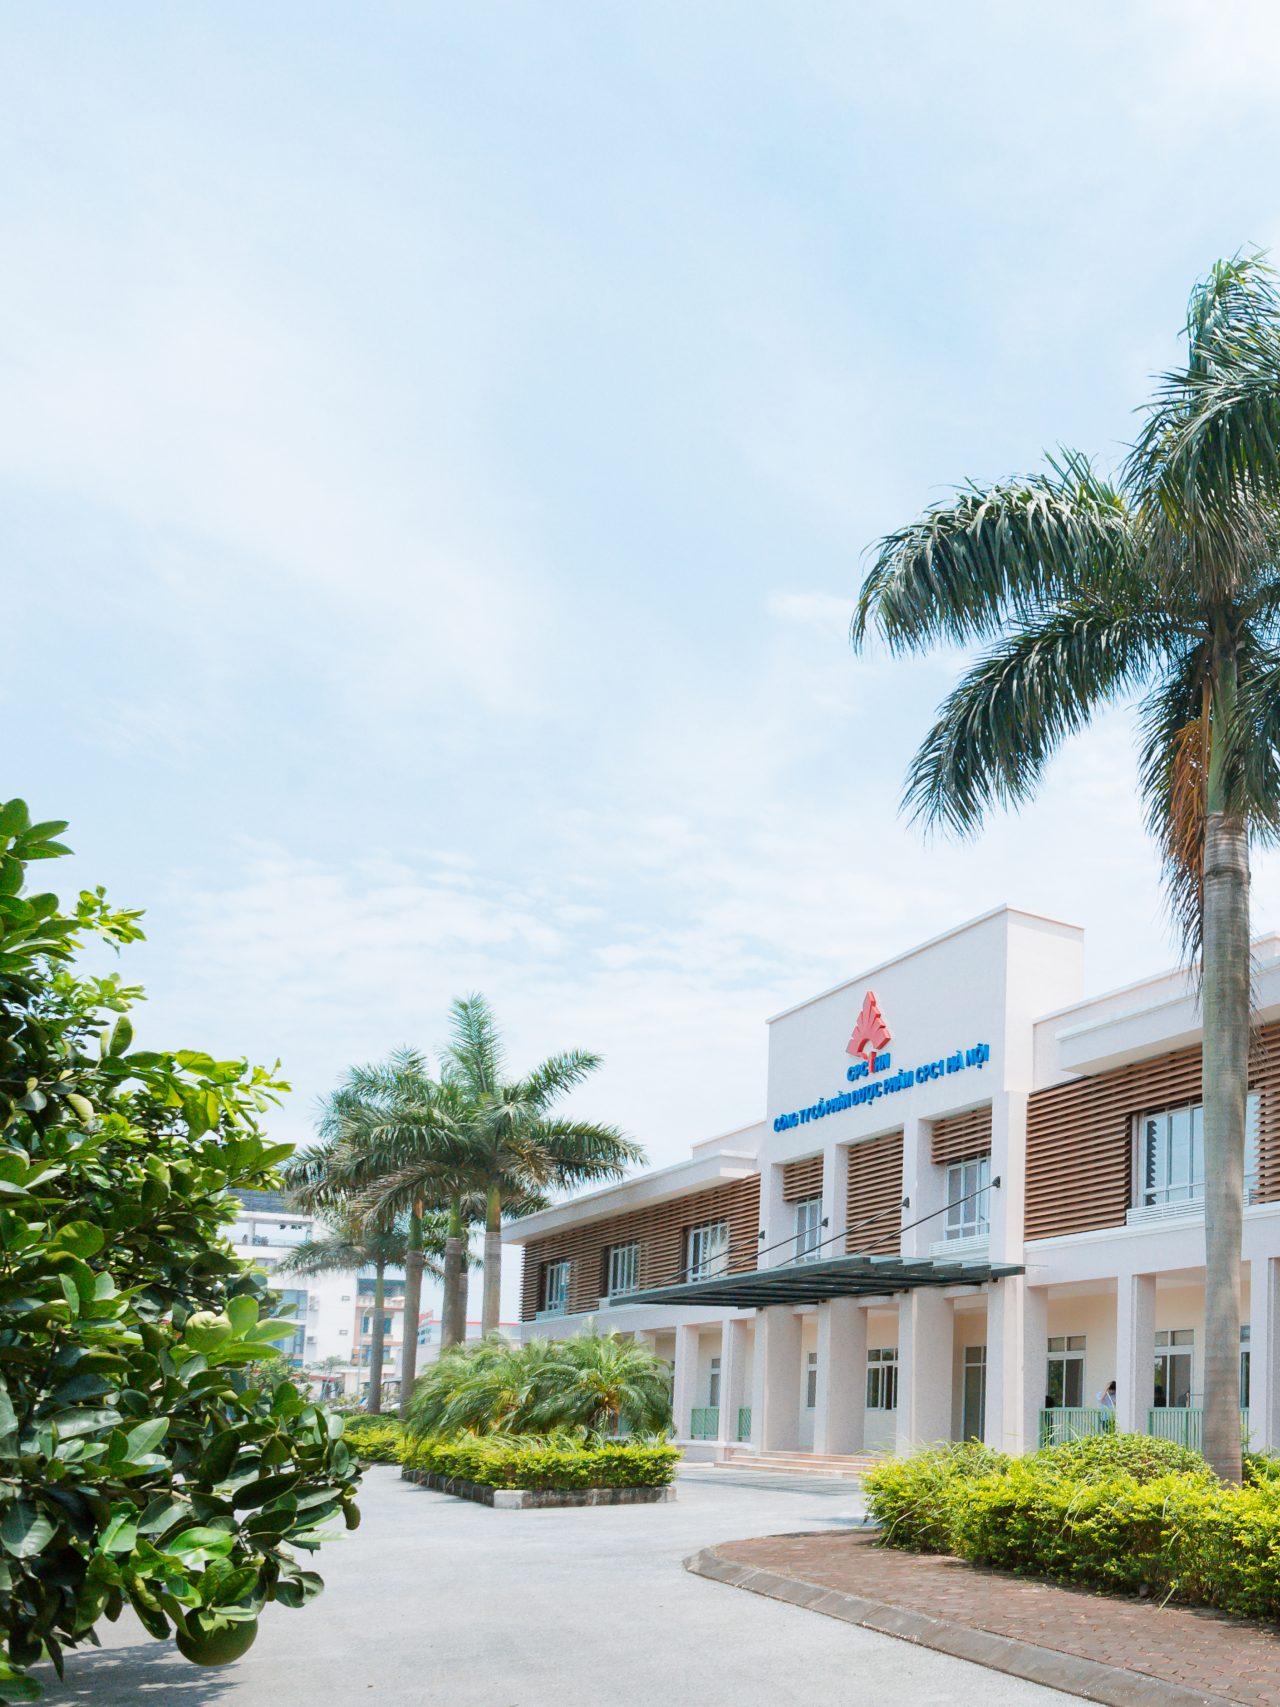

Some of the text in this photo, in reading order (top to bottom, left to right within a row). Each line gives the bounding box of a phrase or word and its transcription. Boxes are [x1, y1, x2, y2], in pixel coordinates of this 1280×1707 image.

[799, 1107, 812, 1124] TY
[915, 1059, 944, 1083] CPC1
[946, 1050, 965, 1074] HÀ
[966, 1043, 989, 1069] NỘI
